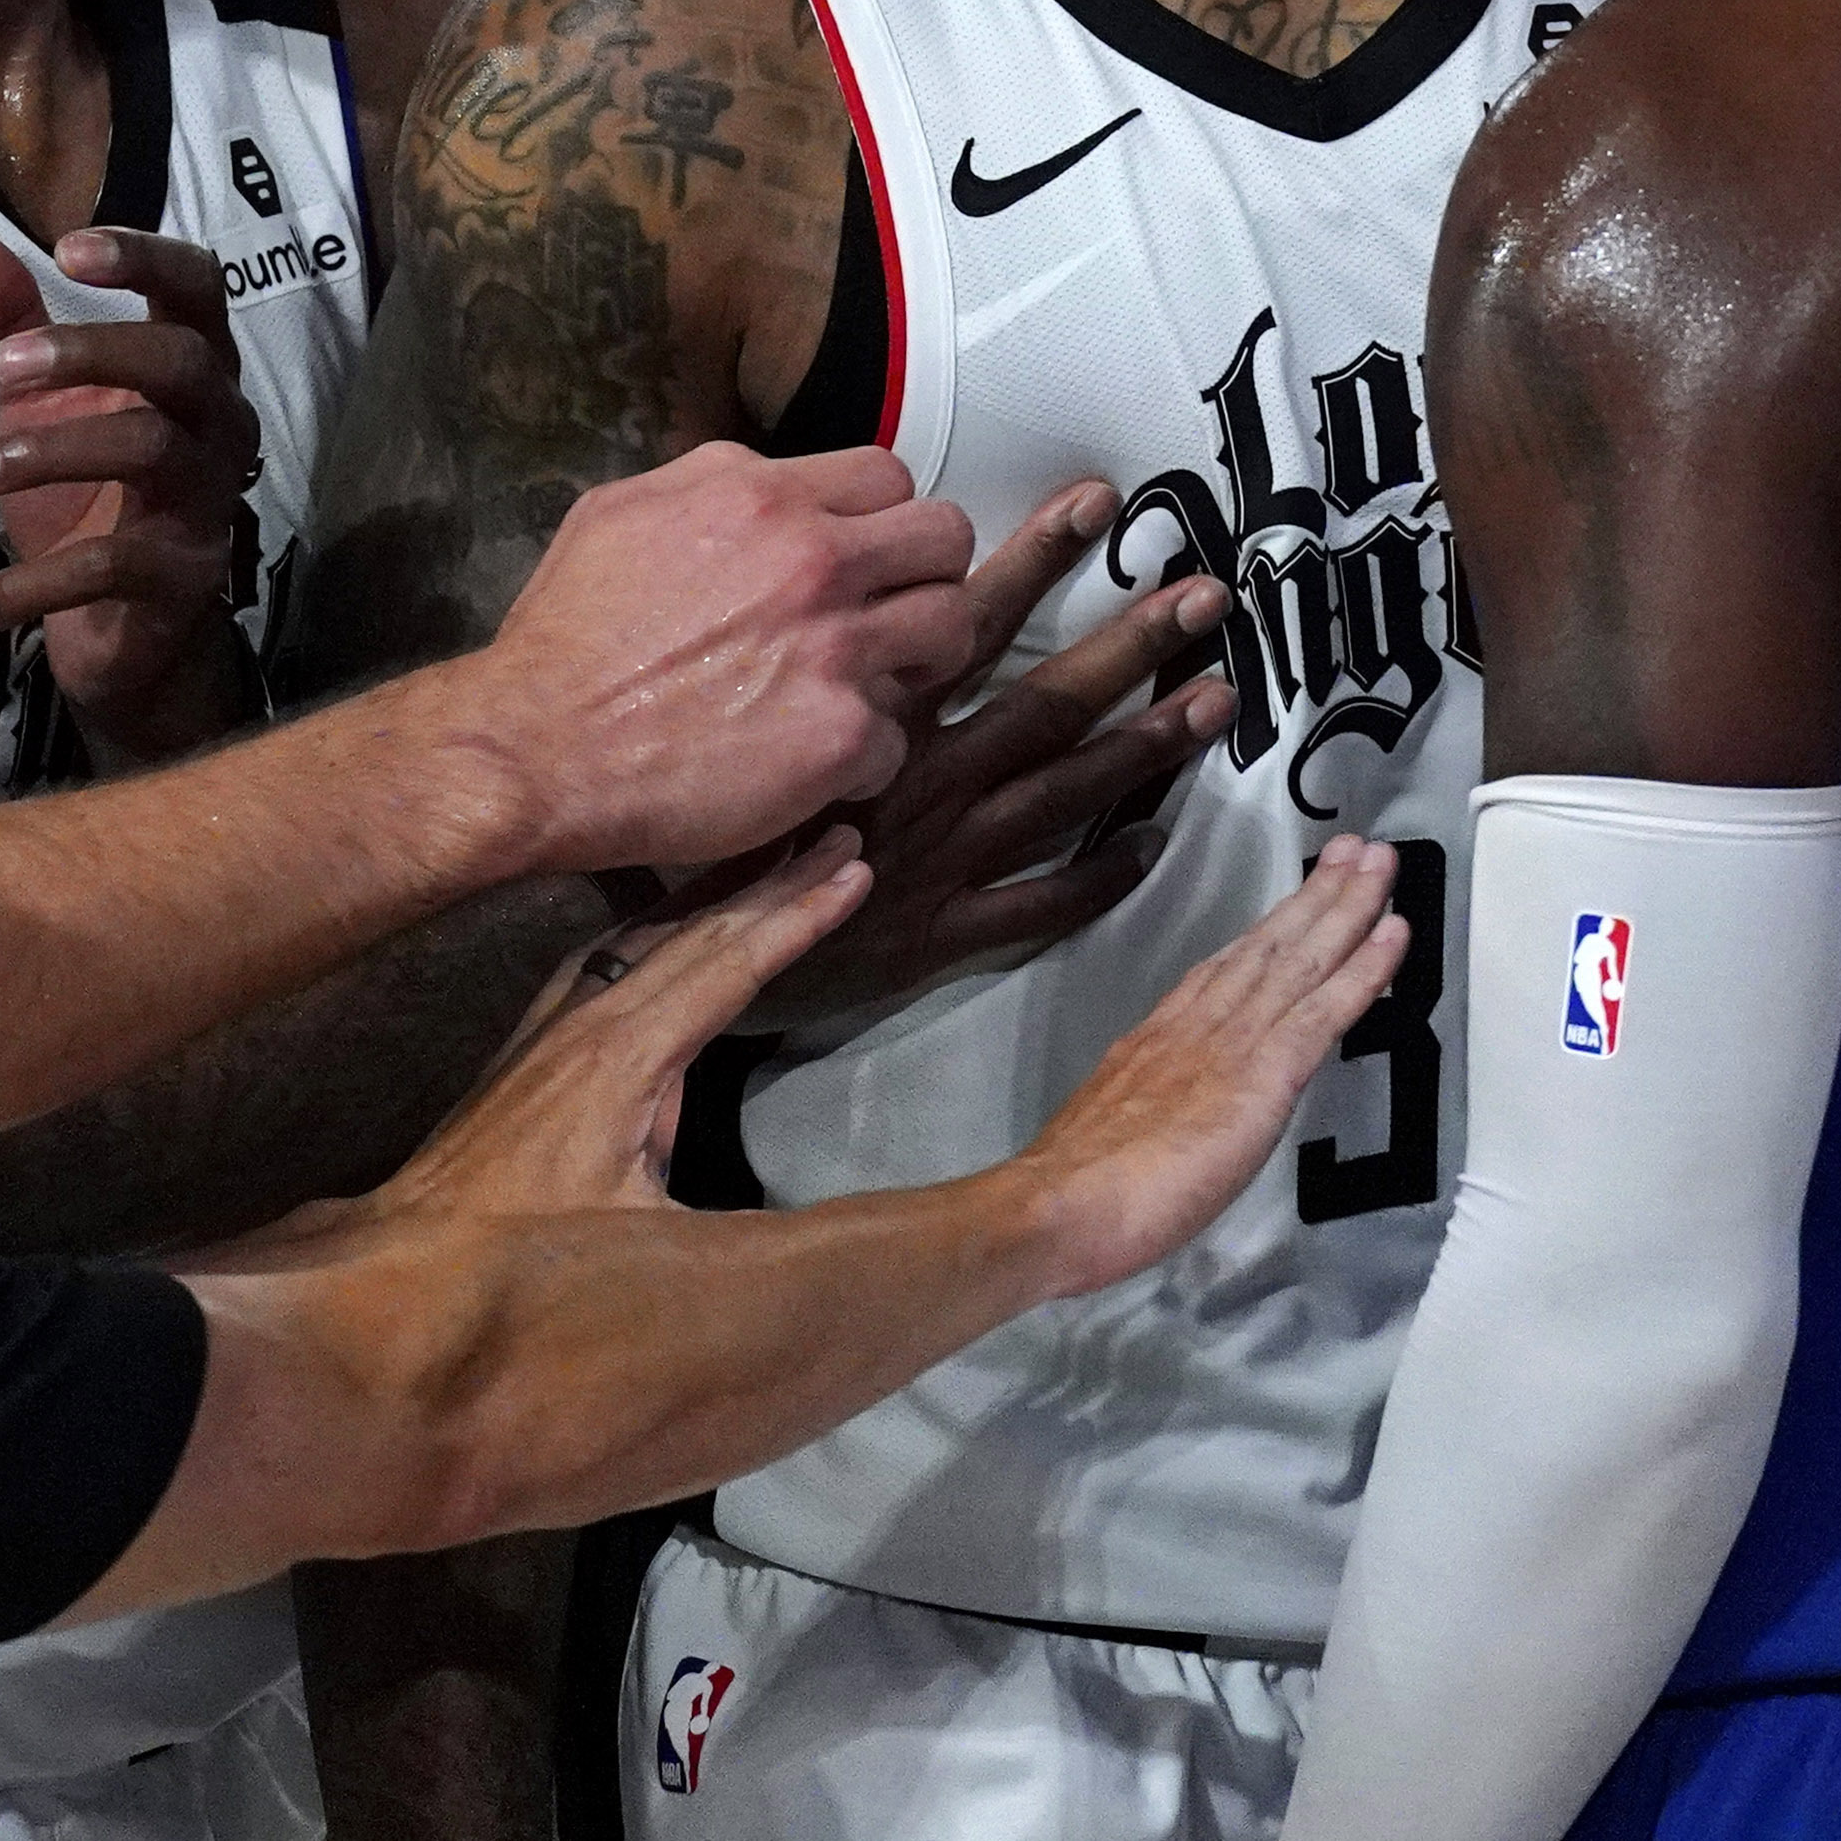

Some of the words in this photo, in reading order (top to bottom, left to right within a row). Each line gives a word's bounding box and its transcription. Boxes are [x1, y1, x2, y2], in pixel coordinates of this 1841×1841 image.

[1200, 306, 1438, 543] Lo
[1297, 838, 1447, 1225] 3
[1565, 1023, 1601, 1048] NBA
[661, 1761, 683, 1787] NBA
